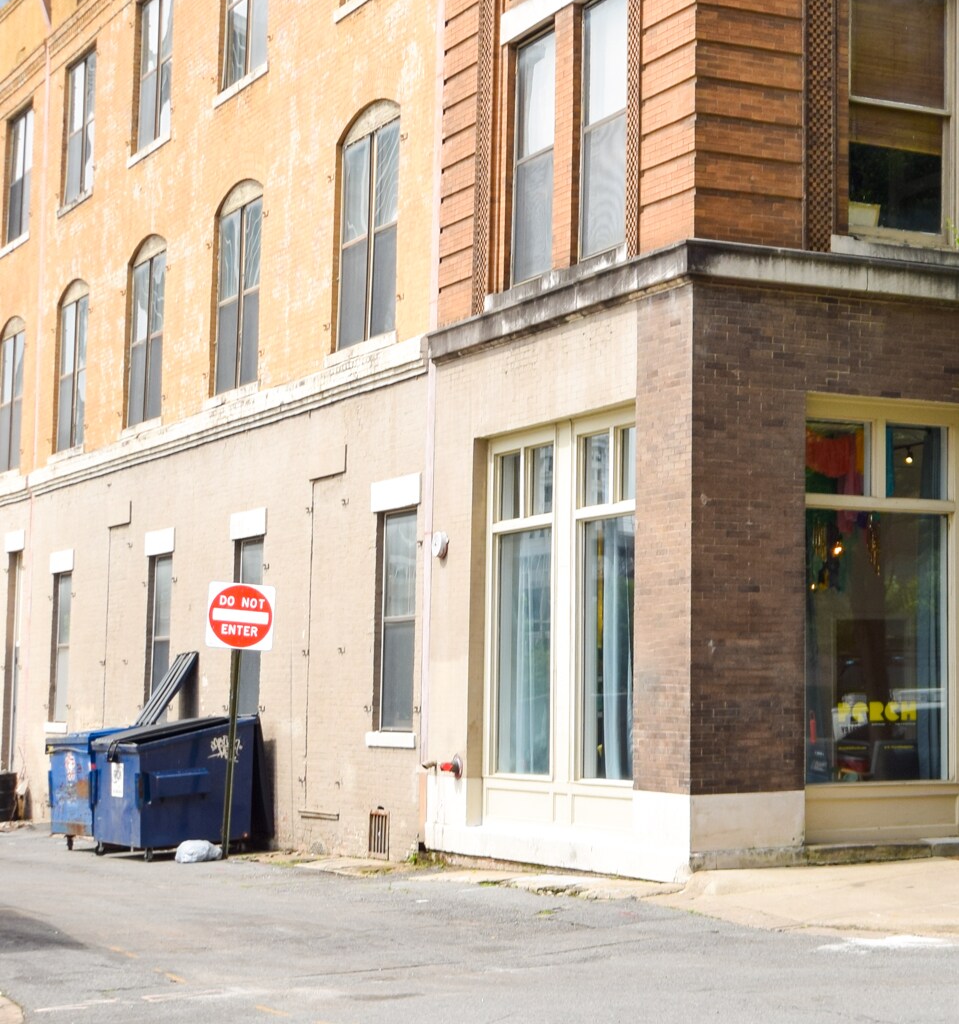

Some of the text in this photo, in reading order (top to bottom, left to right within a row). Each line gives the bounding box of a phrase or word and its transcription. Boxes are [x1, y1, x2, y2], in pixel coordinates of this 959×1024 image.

[219, 594, 266, 610] DO NOT
[221, 623, 259, 637] ENTER
